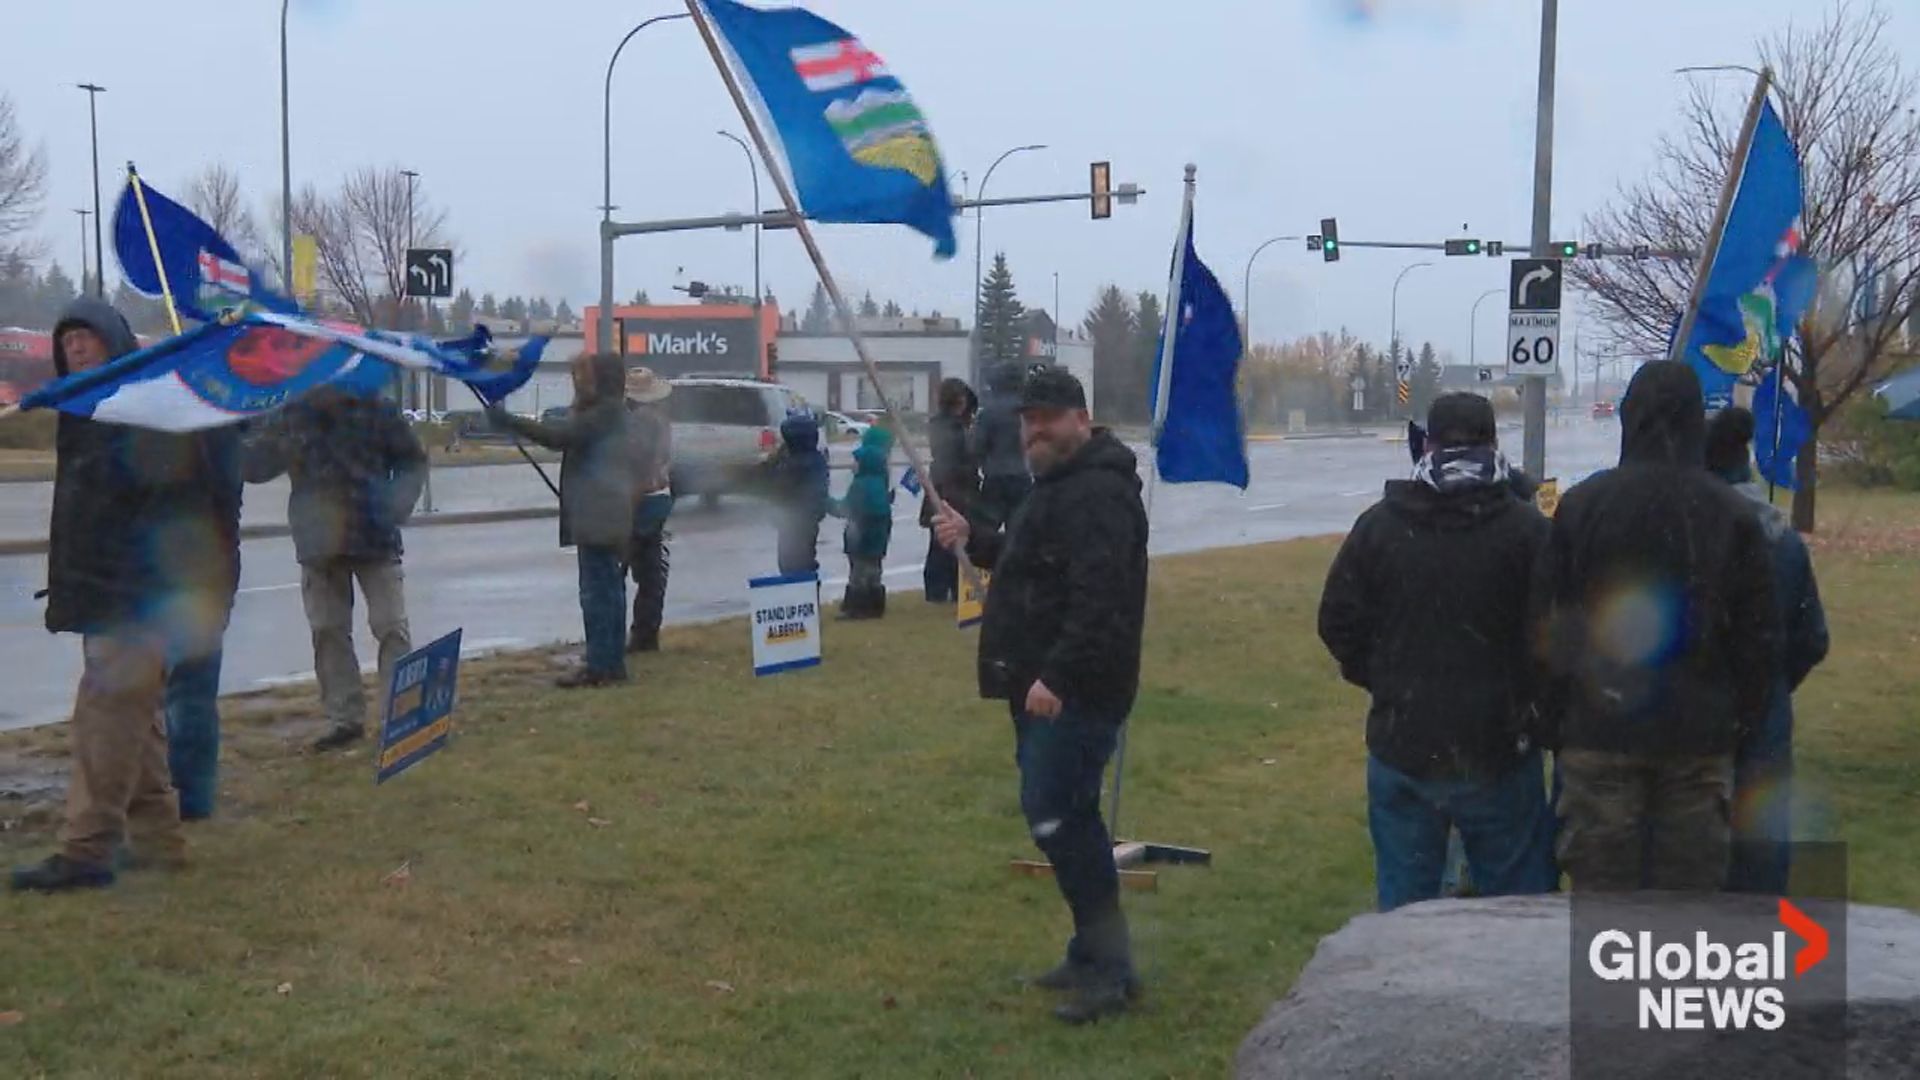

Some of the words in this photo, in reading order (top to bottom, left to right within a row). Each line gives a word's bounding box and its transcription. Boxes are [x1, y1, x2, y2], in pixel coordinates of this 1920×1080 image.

[1511, 316, 1557, 328] MAXIMUM
[648, 331, 728, 354] Mark's
[1512, 336, 1553, 364] 60
[756, 606, 785, 624] STAND
[785, 605, 797, 620] UP
[798, 603, 815, 617] FOR
[768, 621, 805, 638] ALBERTA
